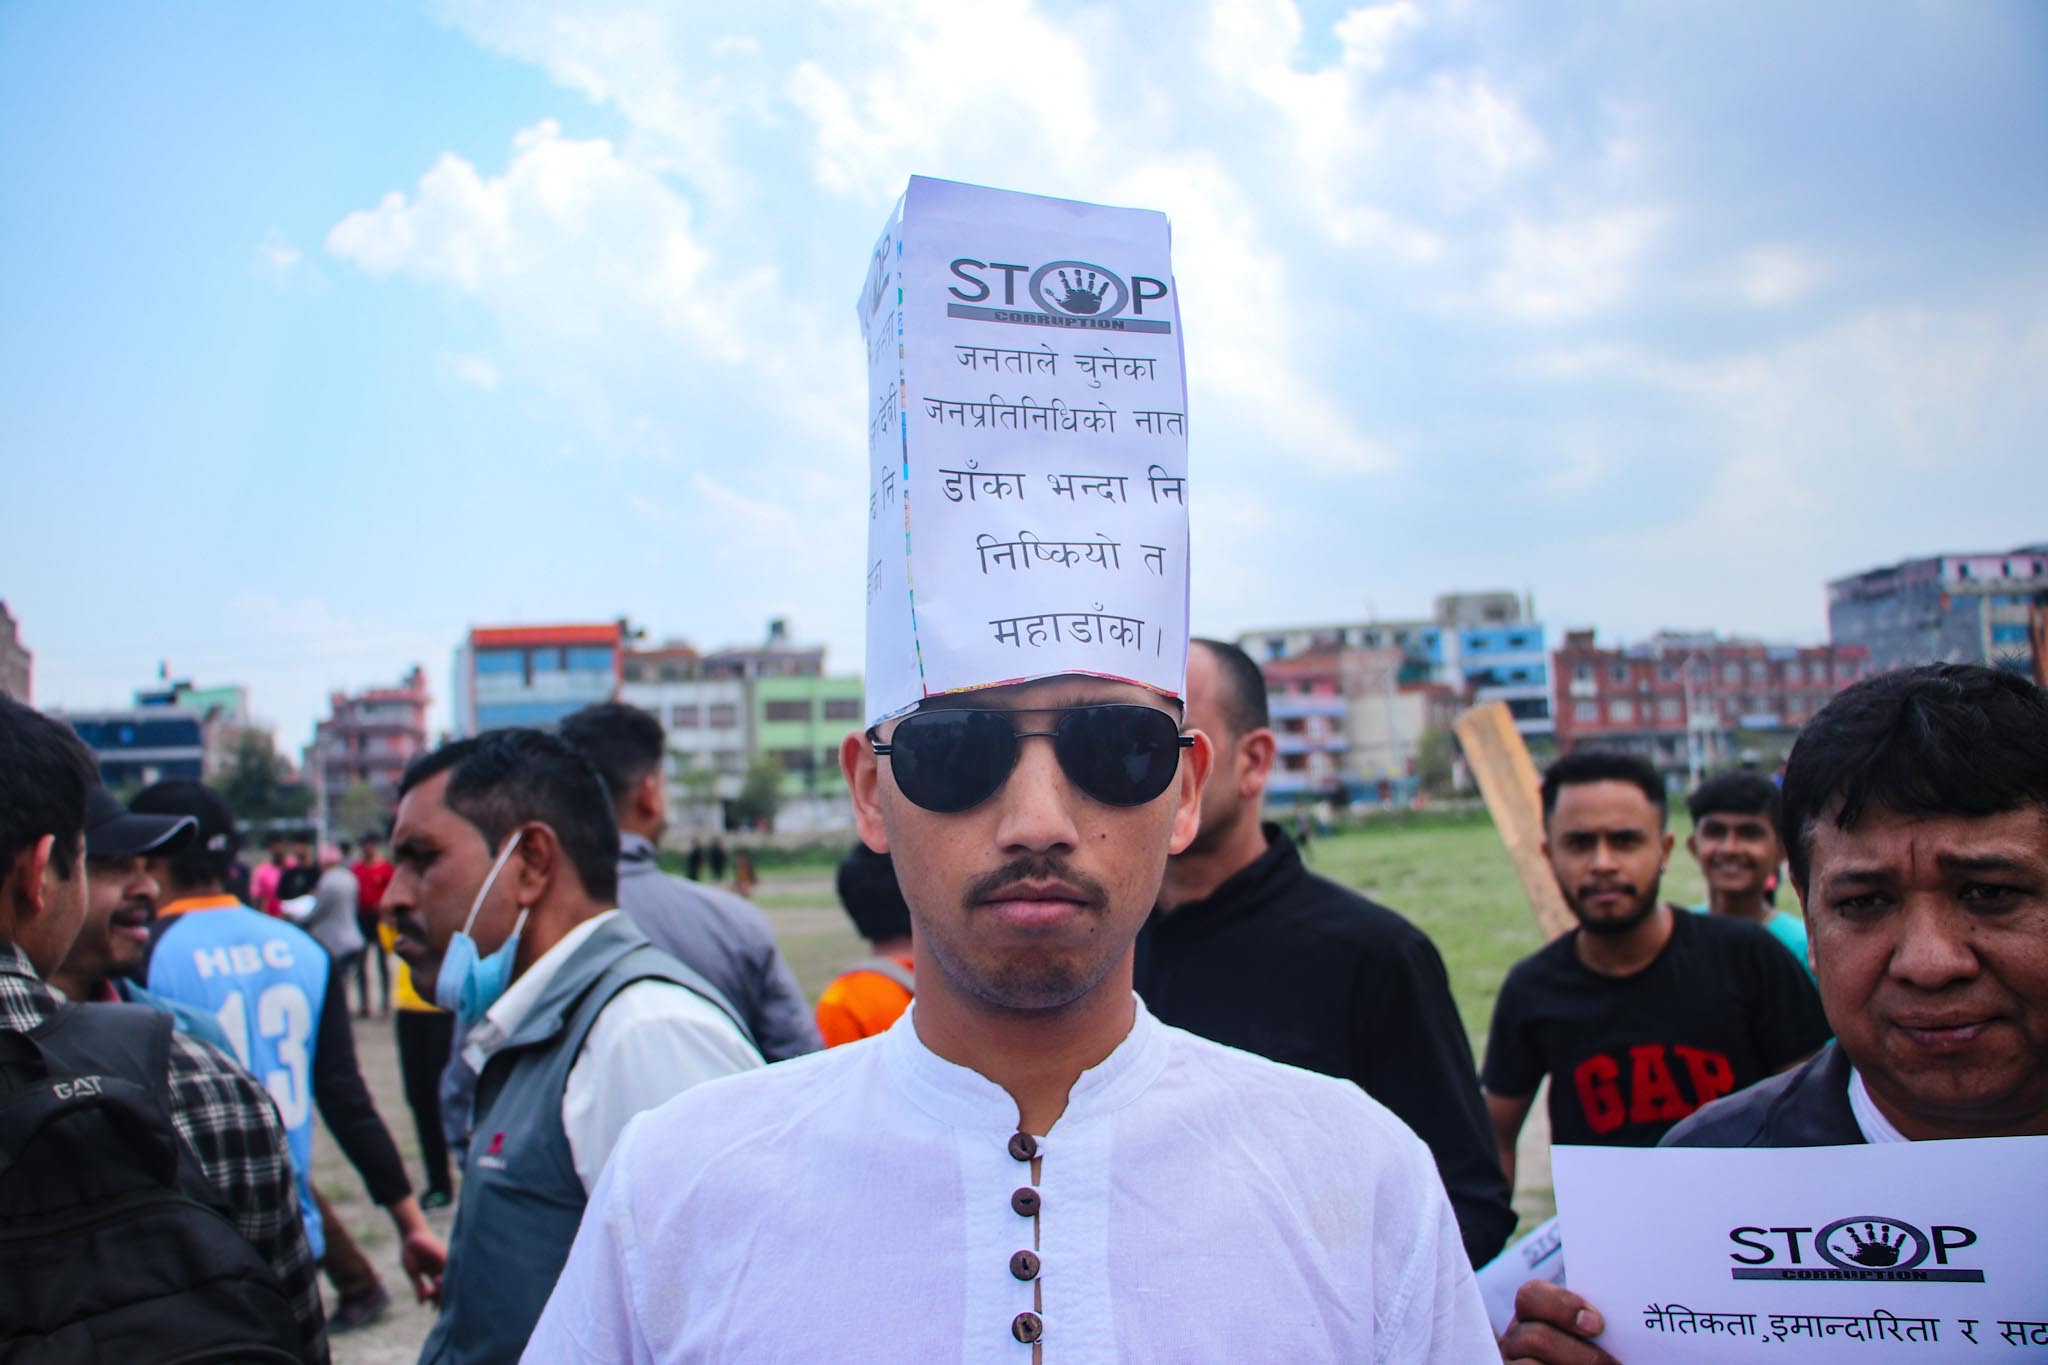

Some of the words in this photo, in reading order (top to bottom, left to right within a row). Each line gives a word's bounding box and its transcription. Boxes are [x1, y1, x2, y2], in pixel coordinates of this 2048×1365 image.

[948, 258, 1168, 317] STOP
[994, 311, 1126, 331] CORRUPTION
[954, 343, 1059, 377] जनताले
[1074, 347, 1157, 389] चुनेका
[923, 393, 1117, 433] जनप्रतिनिधिको
[938, 458, 1026, 503] डाँका
[1047, 473, 1129, 504] भन्दा
[1147, 464, 1186, 506] नि
[1140, 543, 1167, 577] त
[192, 939, 294, 979] HBC
[1573, 1043, 1736, 1135] GAP
[1729, 1216, 1978, 1270] STOP
[1782, 1269, 1928, 1281] CORRUPTION
[1958, 1319, 1979, 1345] र
